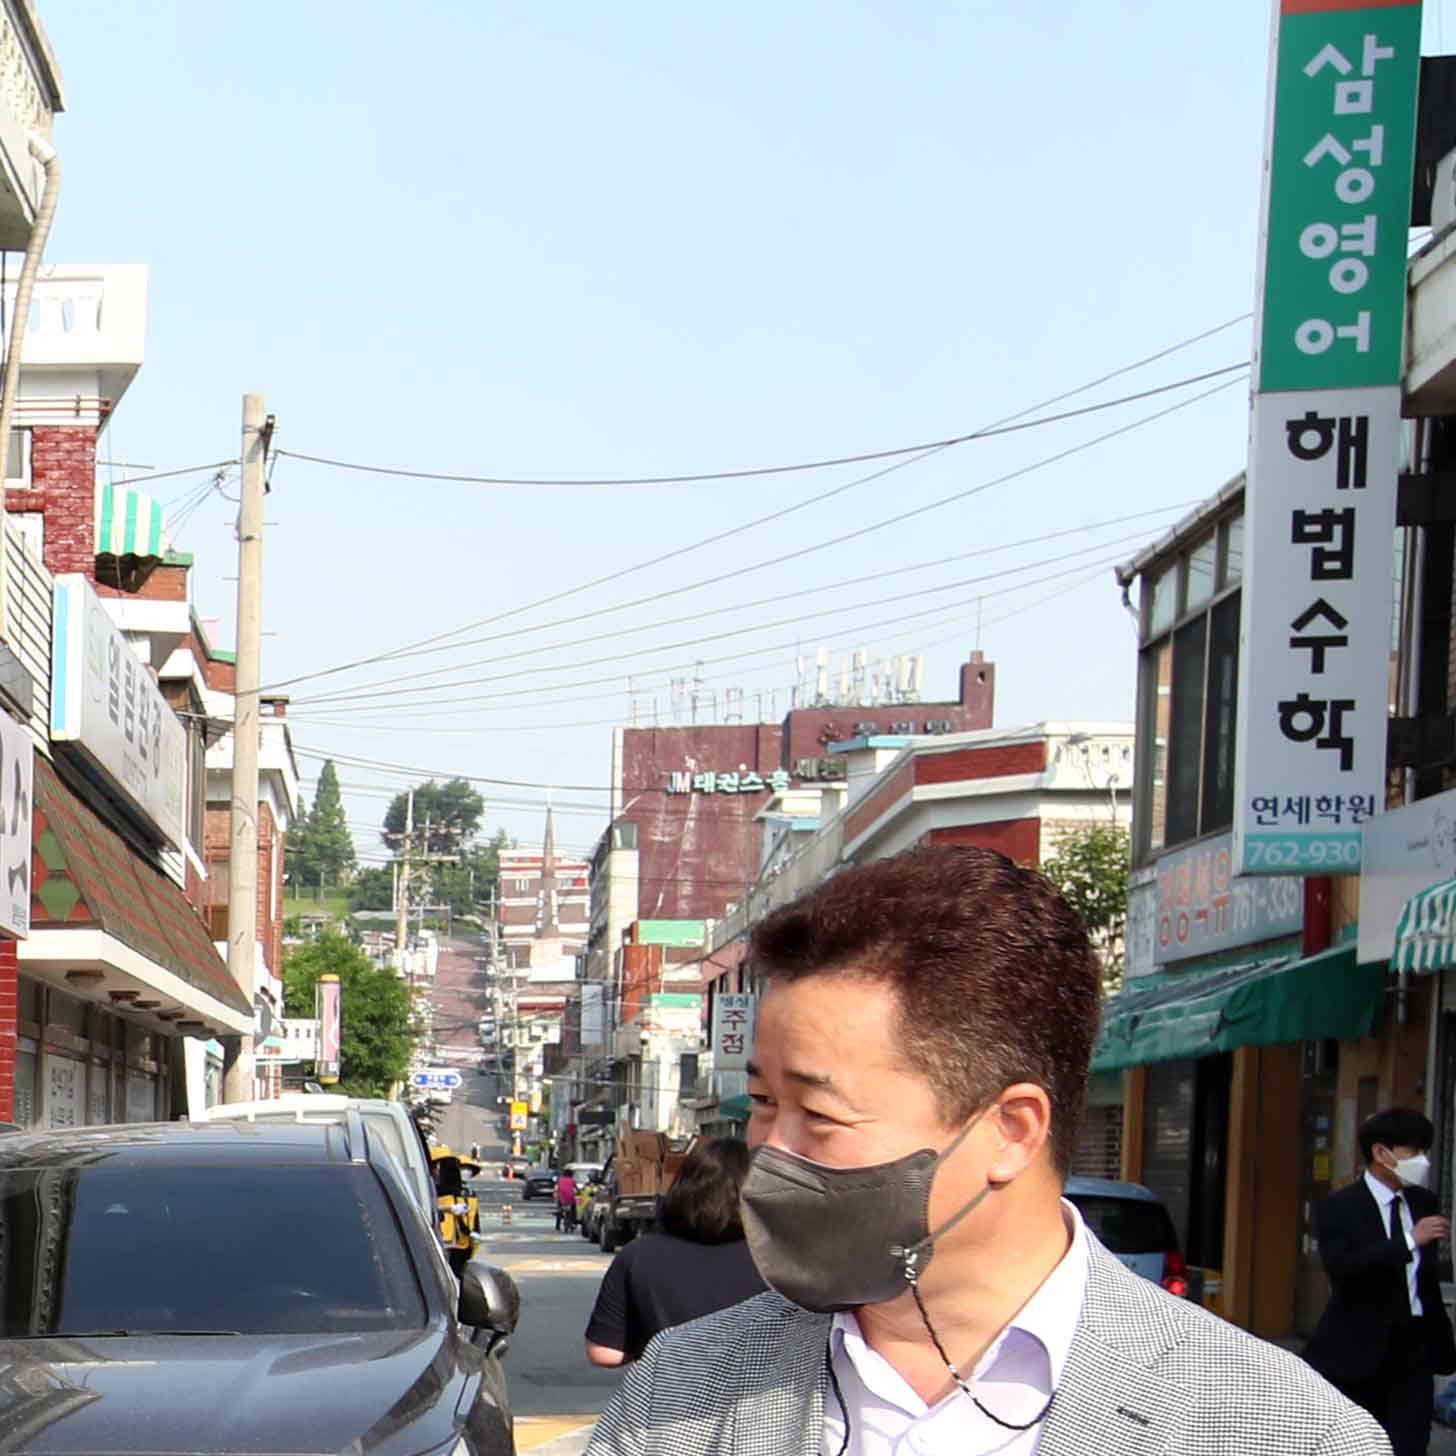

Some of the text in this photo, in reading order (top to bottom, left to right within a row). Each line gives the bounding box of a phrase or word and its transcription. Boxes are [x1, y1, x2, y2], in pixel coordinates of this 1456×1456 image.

[1295, 34, 1395, 355] 삼성영어
[1278, 411, 1369, 771] 해법수학
[1251, 794, 1375, 826] 연세학원
